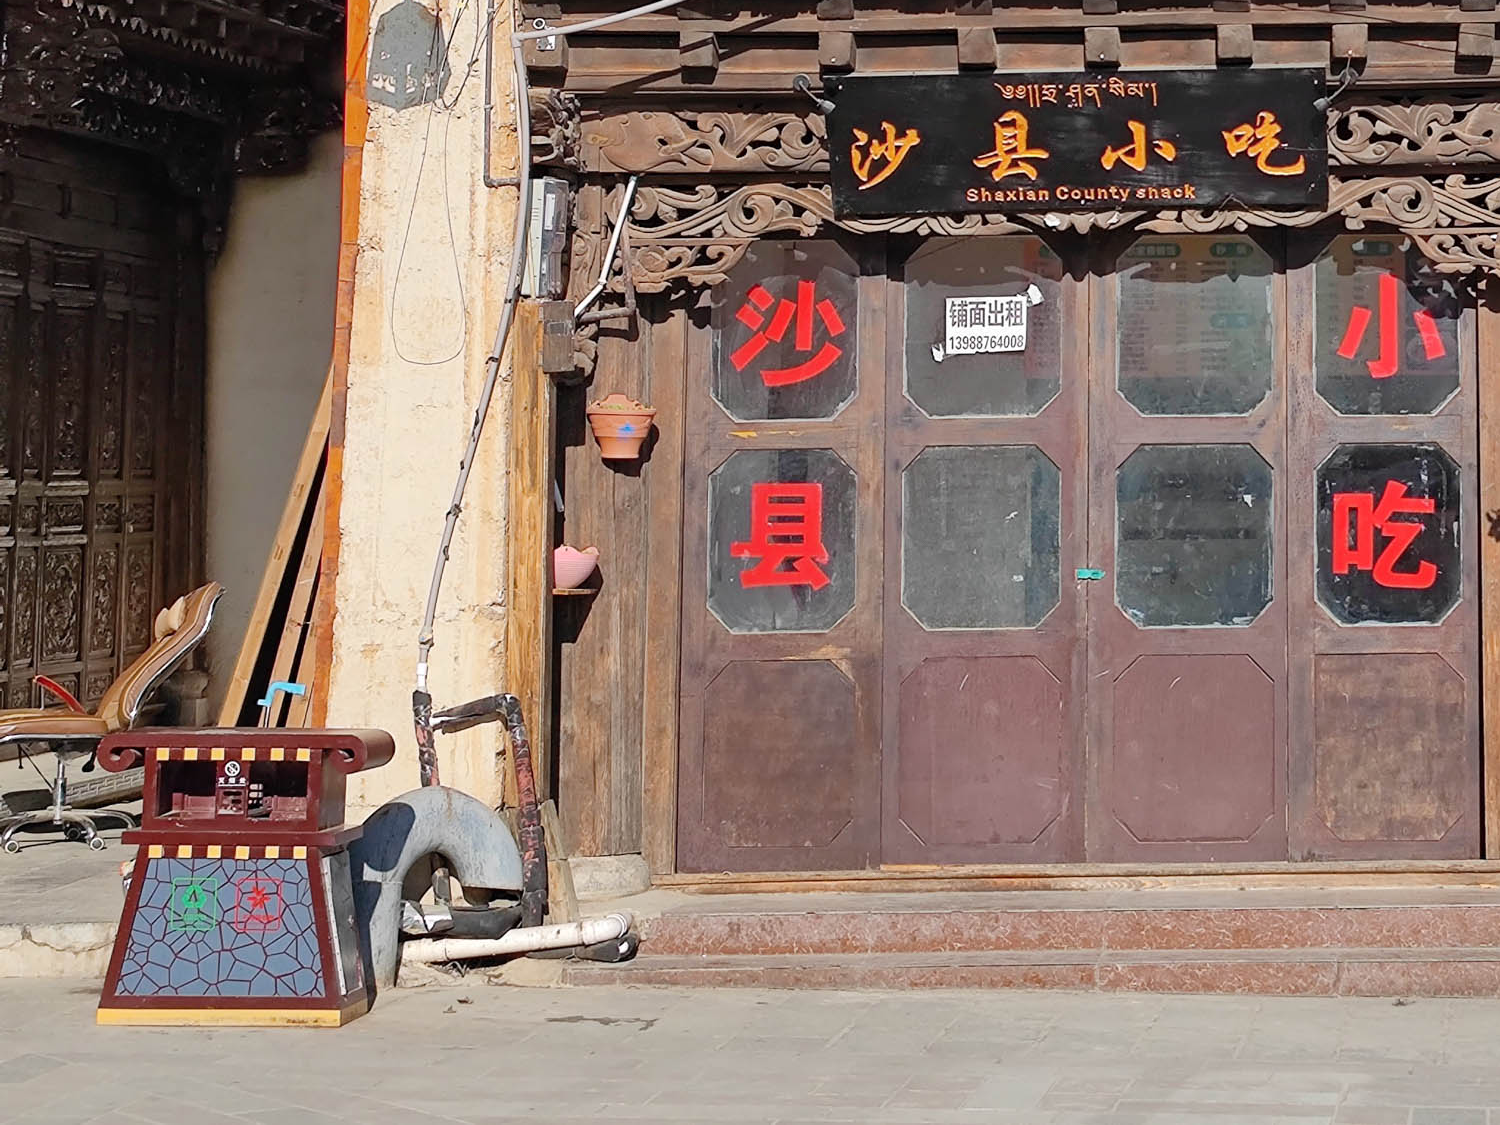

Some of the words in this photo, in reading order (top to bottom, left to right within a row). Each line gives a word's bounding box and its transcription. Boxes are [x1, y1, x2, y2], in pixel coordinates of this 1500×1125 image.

[850, 110, 1305, 190] 沙县小吃
[966, 187, 1049, 202] Shaxian
[1056, 185, 1130, 202] County
[1136, 183, 1196, 199] shack
[949, 300, 1024, 328] 铺面出租
[949, 335, 1024, 350] 13988764008
